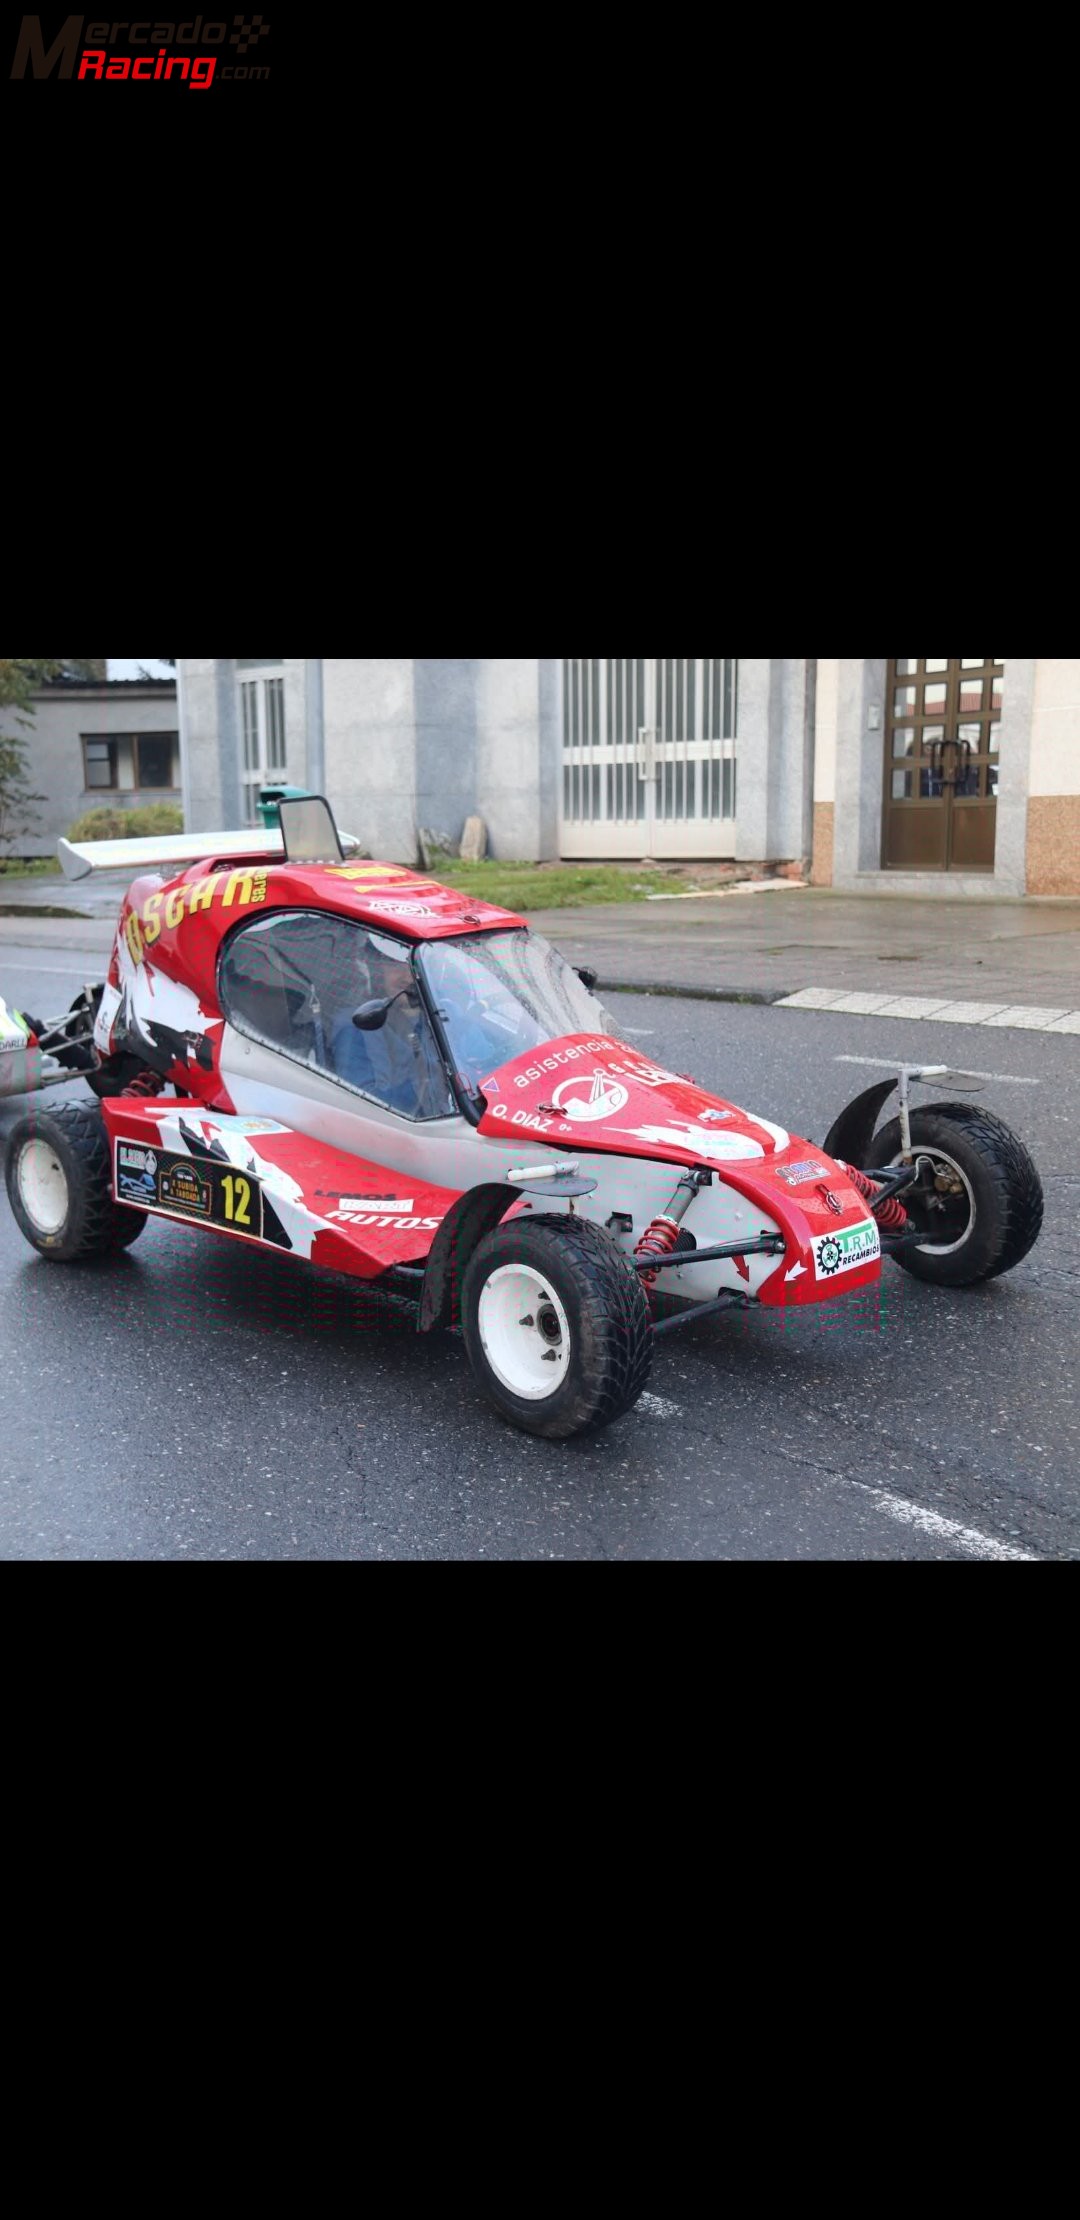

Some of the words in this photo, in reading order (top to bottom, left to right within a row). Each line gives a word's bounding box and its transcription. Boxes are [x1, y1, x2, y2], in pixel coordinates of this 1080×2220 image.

[514, 1040, 615, 1088] asistencia
[492, 1104, 507, 1119] O.
[511, 1110, 554, 1132] DIAZ
[221, 1175, 250, 1225] 12
[323, 1210, 444, 1230] AUTOS
[842, 1244, 880, 1265] RECAMBIOS
